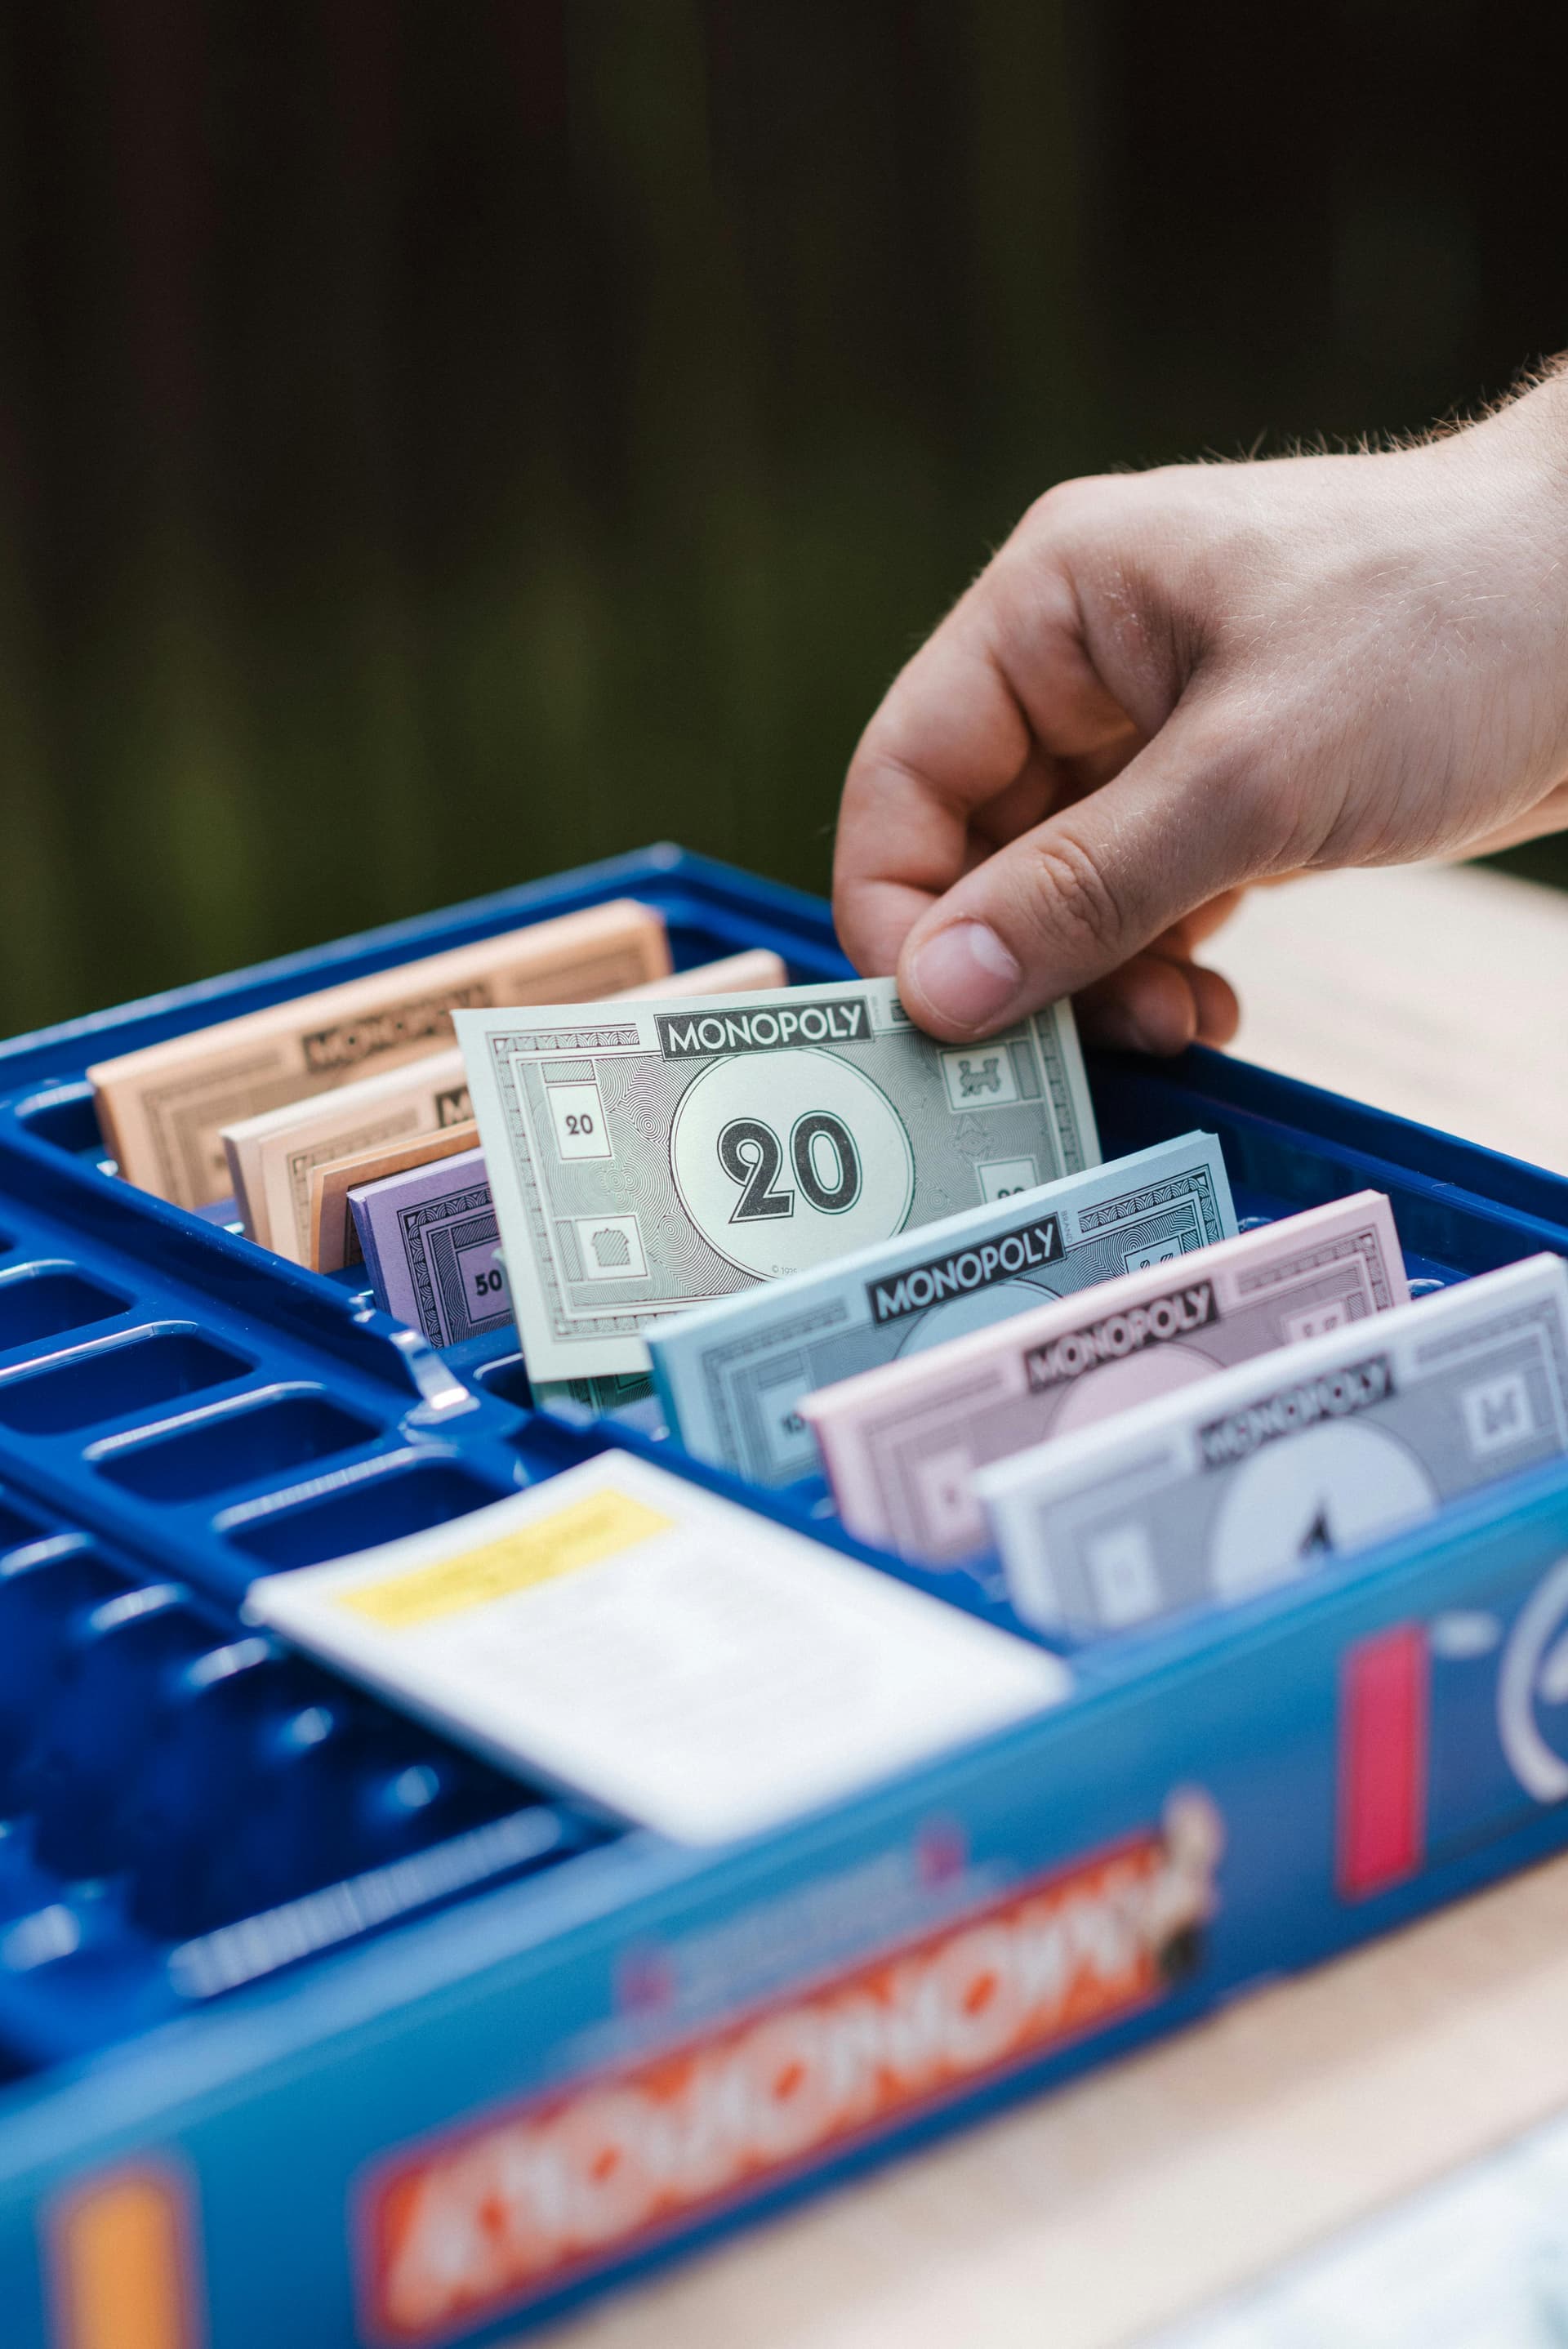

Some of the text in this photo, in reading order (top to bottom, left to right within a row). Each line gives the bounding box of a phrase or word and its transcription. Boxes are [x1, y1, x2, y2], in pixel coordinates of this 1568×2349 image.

[667, 1005, 862, 1053] MONOPOLY
[565, 1113, 595, 1135] 20
[716, 1109, 863, 1224] 20
[474, 1269, 503, 1296] 50
[875, 1223, 1054, 1320] MONOPOLY
[1027, 1283, 1212, 1382] MONOPOLY
